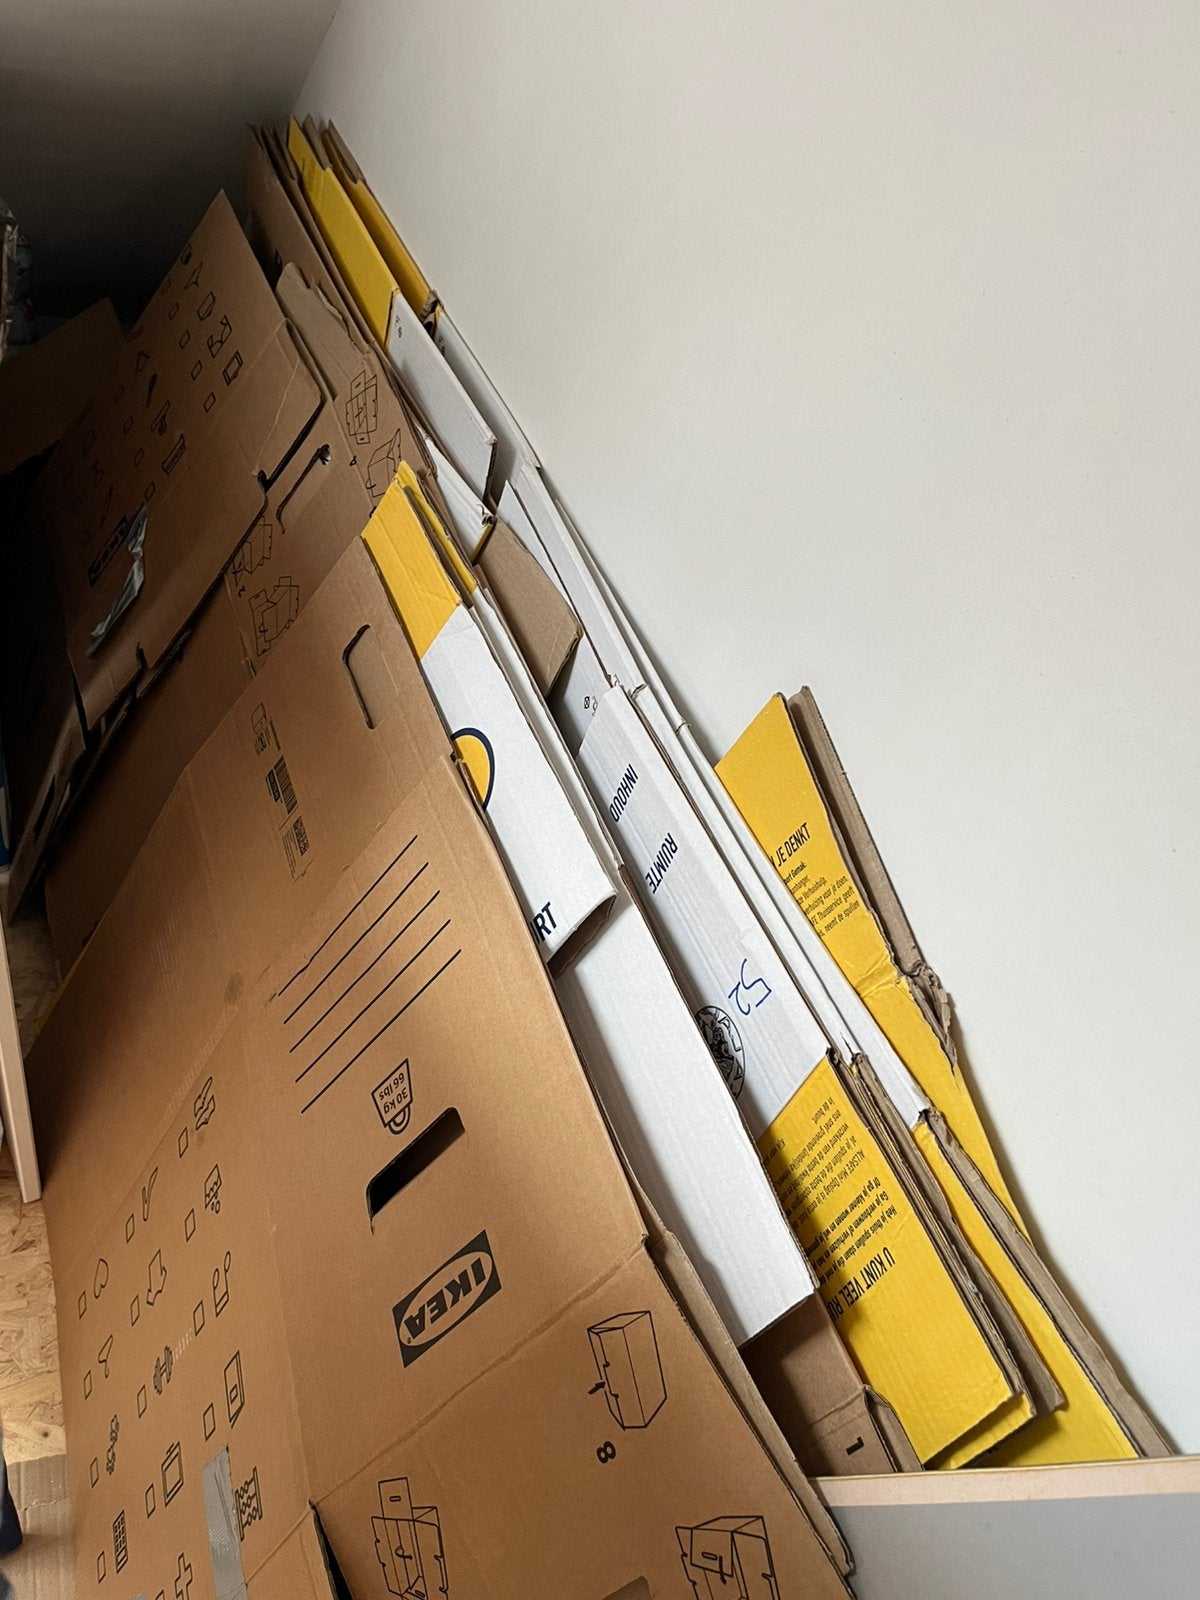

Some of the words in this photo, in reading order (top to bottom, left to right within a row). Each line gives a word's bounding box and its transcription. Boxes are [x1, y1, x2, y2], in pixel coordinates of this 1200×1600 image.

[609, 763, 639, 823] INHOUD
[775, 846, 786, 867] JE
[783, 822, 810, 857] DENKT
[645, 832, 679, 895] RUIMTE
[530, 901, 557, 944] RT
[392, 1072, 405, 1091] 66
[378, 1083, 394, 1102] lbs
[396, 1086, 410, 1106] 30
[383, 1094, 396, 1115] kg
[829, 1122, 848, 1147] verzekerd
[807, 1157, 819, 1172] beste
[832, 1146, 847, 1166] spullen
[846, 1149, 864, 1173] ALLSAFE
[810, 1175, 822, 1190] beste
[837, 1167, 848, 1182] Mini
[823, 1177, 839, 1195] Opslag
[849, 1194, 864, 1212] kleiner
[835, 1209, 849, 1225] wonen
[854, 1202, 876, 1228] verbouwen
[870, 1219, 883, 1234] thuis
[830, 1230, 849, 1253] verhuizen
[855, 1229, 871, 1249] spullen
[883, 1247, 895, 1266] U
[860, 1254, 886, 1288] KUNT
[404, 1257, 487, 1341] IKEA
[839, 1277, 864, 1307] VEEL
[596, 1440, 617, 1464] 8
